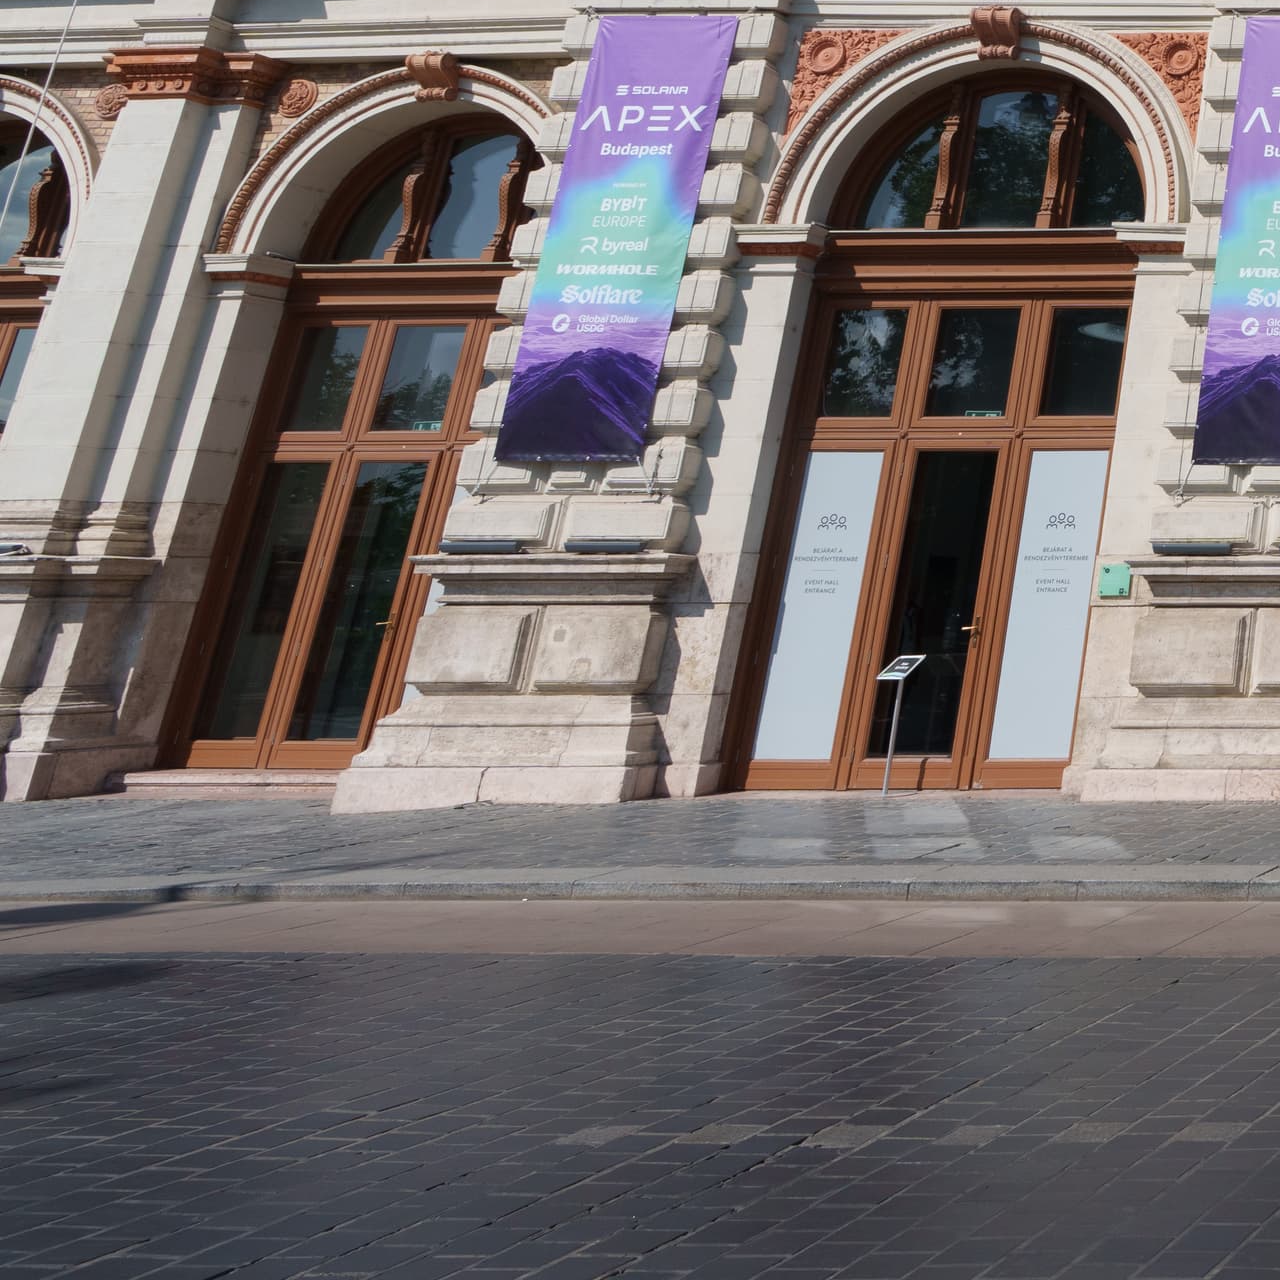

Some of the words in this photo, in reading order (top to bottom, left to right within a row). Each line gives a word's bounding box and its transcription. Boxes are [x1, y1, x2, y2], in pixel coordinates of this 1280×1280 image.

[632, 86, 688, 94] SOLANA
[580, 105, 708, 132] APEX
[600, 142, 673, 158] Budapest
[600, 195, 648, 212] BYBIT
[592, 216, 647, 228] EUROPE
[601, 237, 648, 255] byreal
[556, 264, 658, 275] WORMHOLE
[560, 284, 643, 304] Solflare
[578, 314, 608, 323] Global
[609, 314, 638, 324] Dollar
[576, 324, 604, 332] USDG
